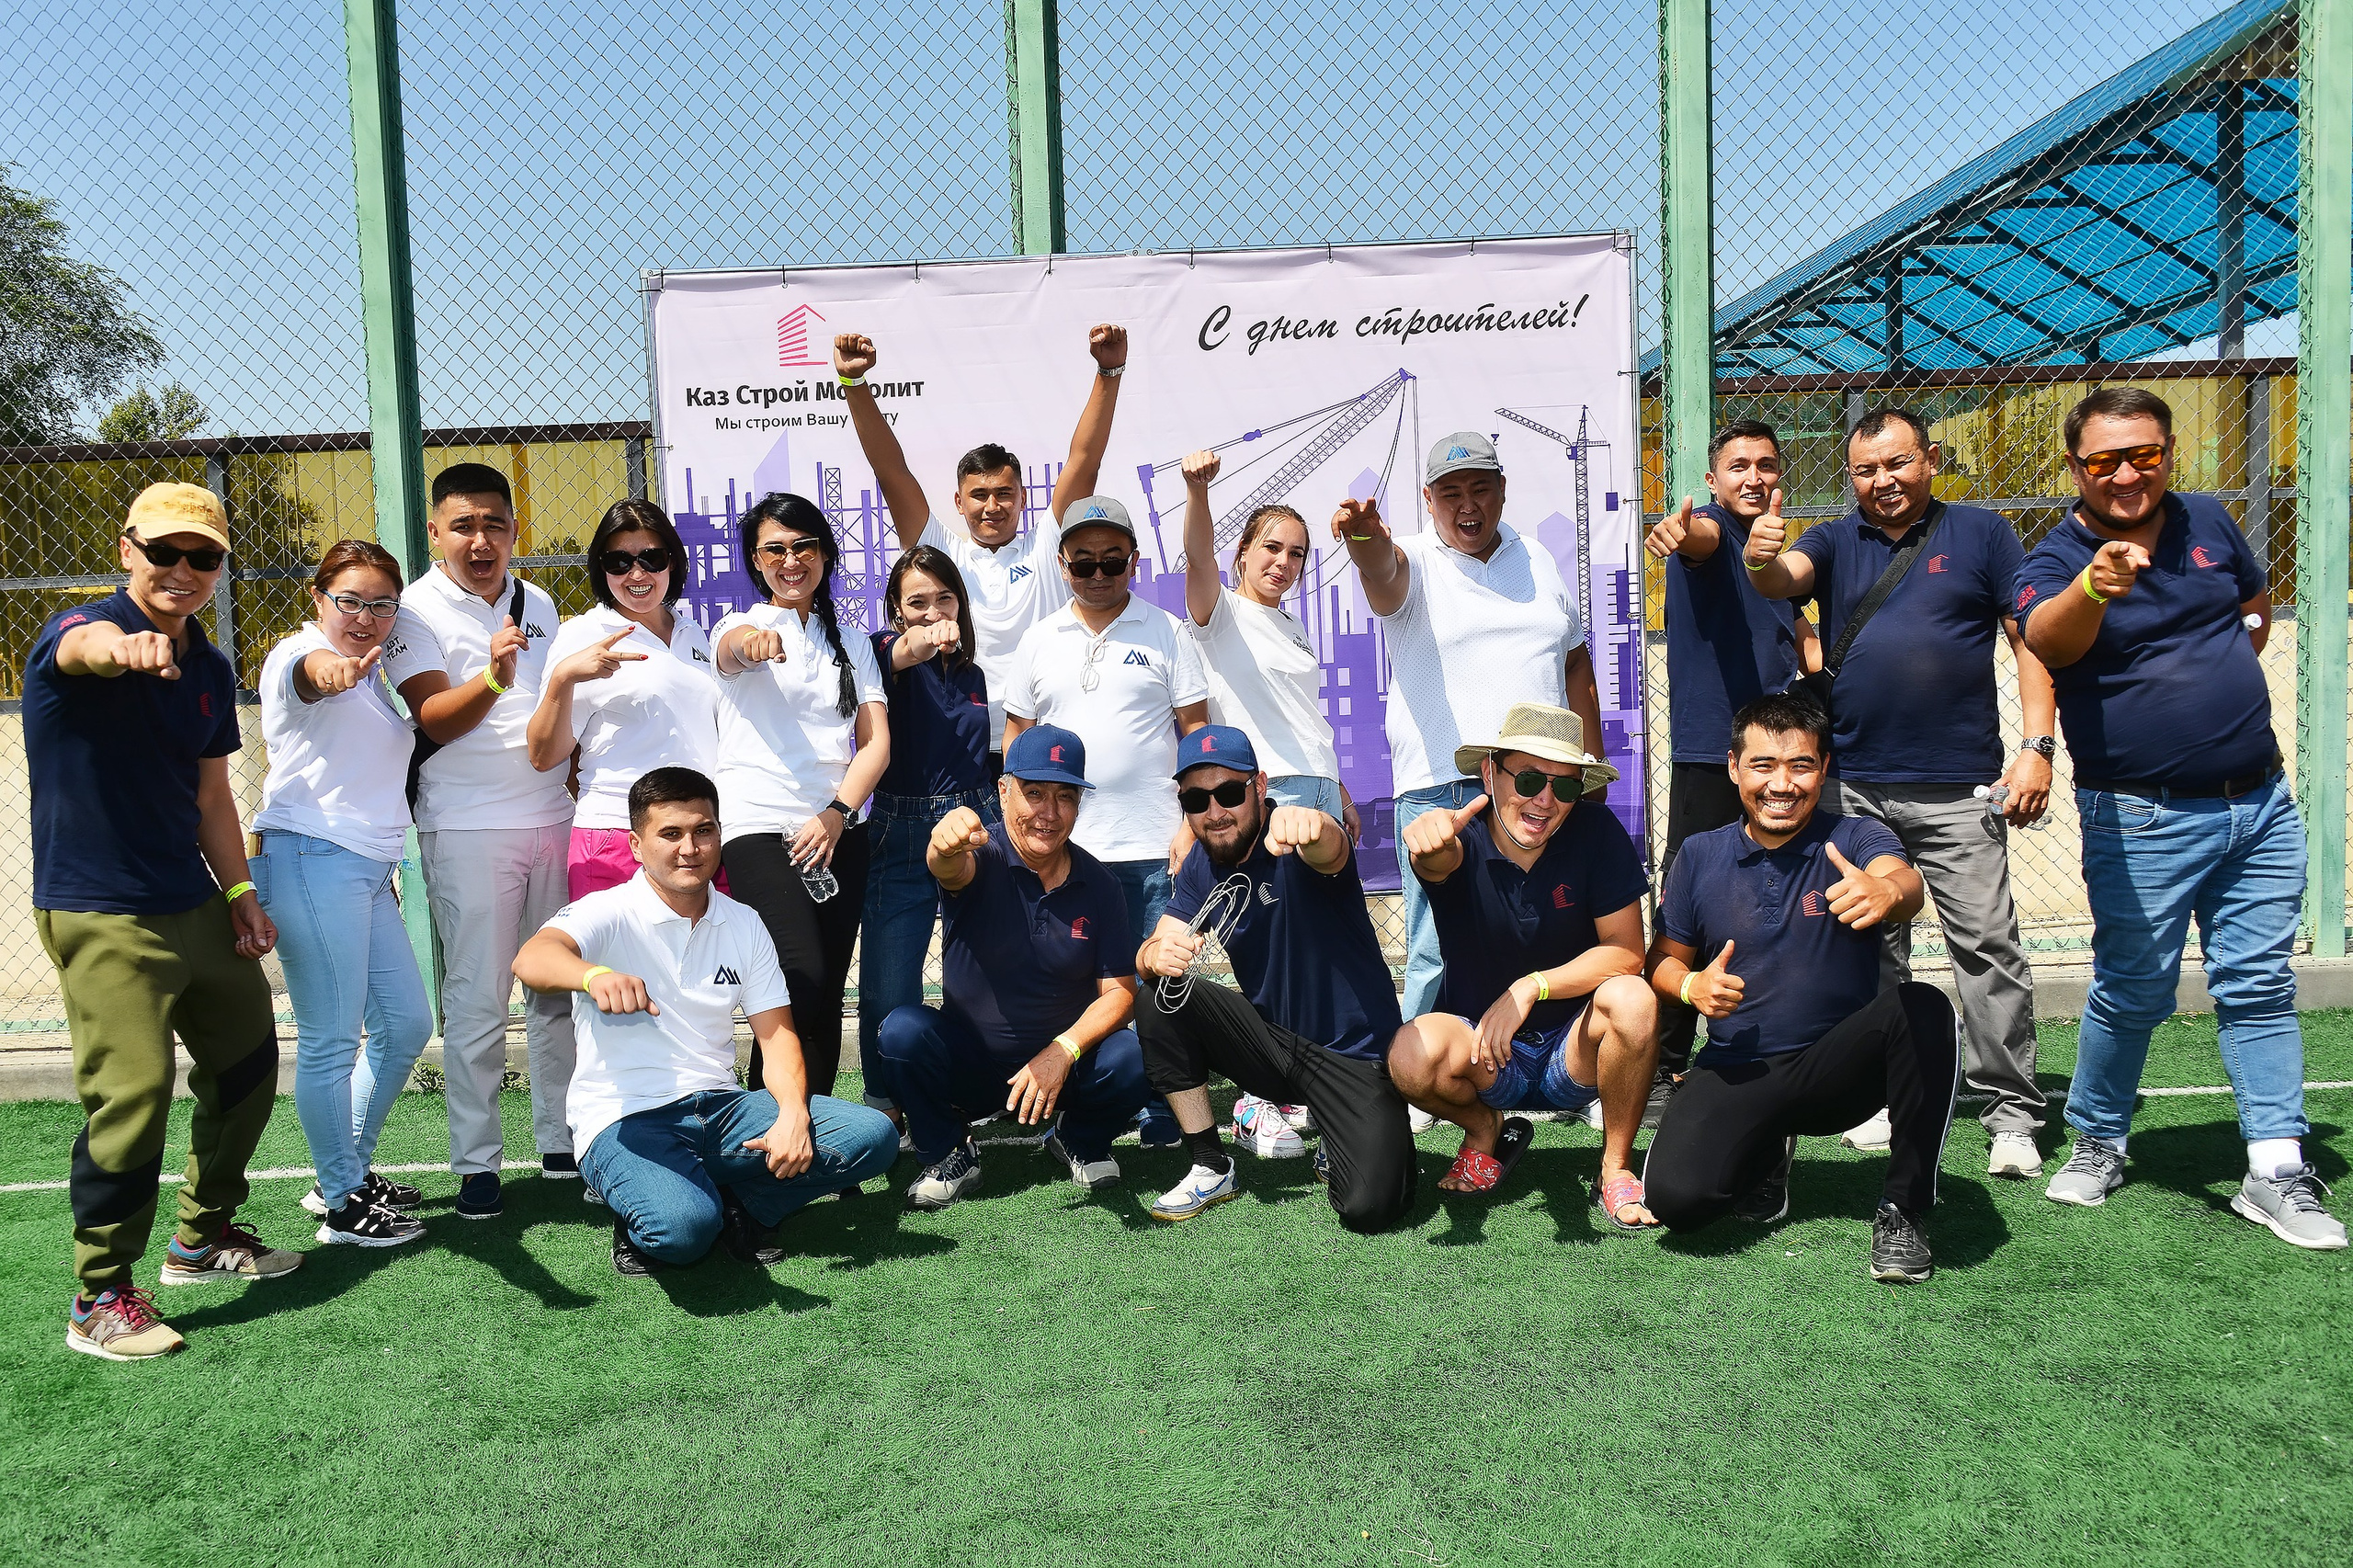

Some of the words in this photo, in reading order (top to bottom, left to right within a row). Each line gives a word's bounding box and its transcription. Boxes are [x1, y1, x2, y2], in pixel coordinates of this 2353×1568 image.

[1198, 304, 1232, 351] С
[1246, 319, 1338, 356] днем
[1355, 293, 1590, 345] строителей!
[686, 387, 730, 406] Каз
[736, 380, 809, 409] Строй
[815, 381, 925, 401] Моолит
[715, 416, 742, 430] Мы
[745, 416, 802, 432] строим
[807, 413, 847, 428] Вашу
[386, 636, 400, 653] ABT
[386, 643, 408, 662] TEAM
